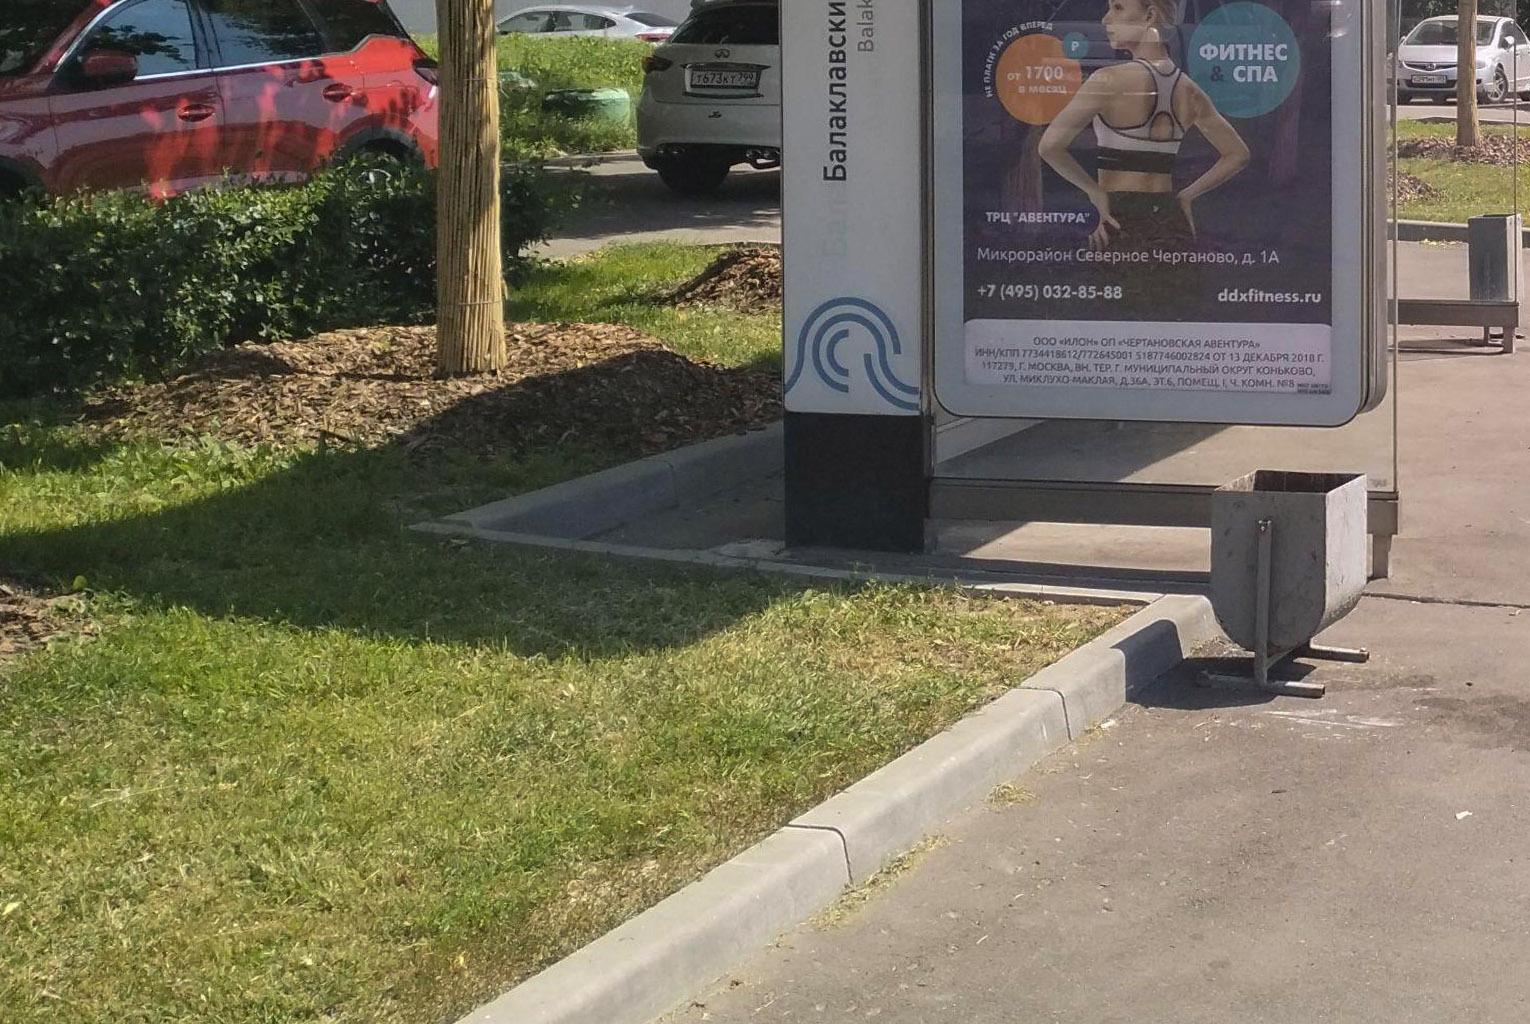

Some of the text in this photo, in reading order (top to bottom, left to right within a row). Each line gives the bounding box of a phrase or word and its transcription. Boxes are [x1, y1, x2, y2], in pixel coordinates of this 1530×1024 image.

[1199, 43, 1288, 61] ФИТНЕС
[1025, 66, 1064, 82] 1700
[1211, 65, 1279, 82] & СПА
[986, 211, 1091, 225] ТРЦ "АВЕНТУРА"
[977, 246, 1072, 263] Микрорайон
[1075, 247, 1149, 265] Северное
[1153, 248, 1238, 265] Чертаново,
[977, 284, 1123, 300] +7 (495) 032-85-88
[1217, 287, 1322, 304] ddxfitness.ru
[1242, 352, 1289, 363] ДЕКАБРЯ
[1222, 365, 1254, 375] ОКРУГ
